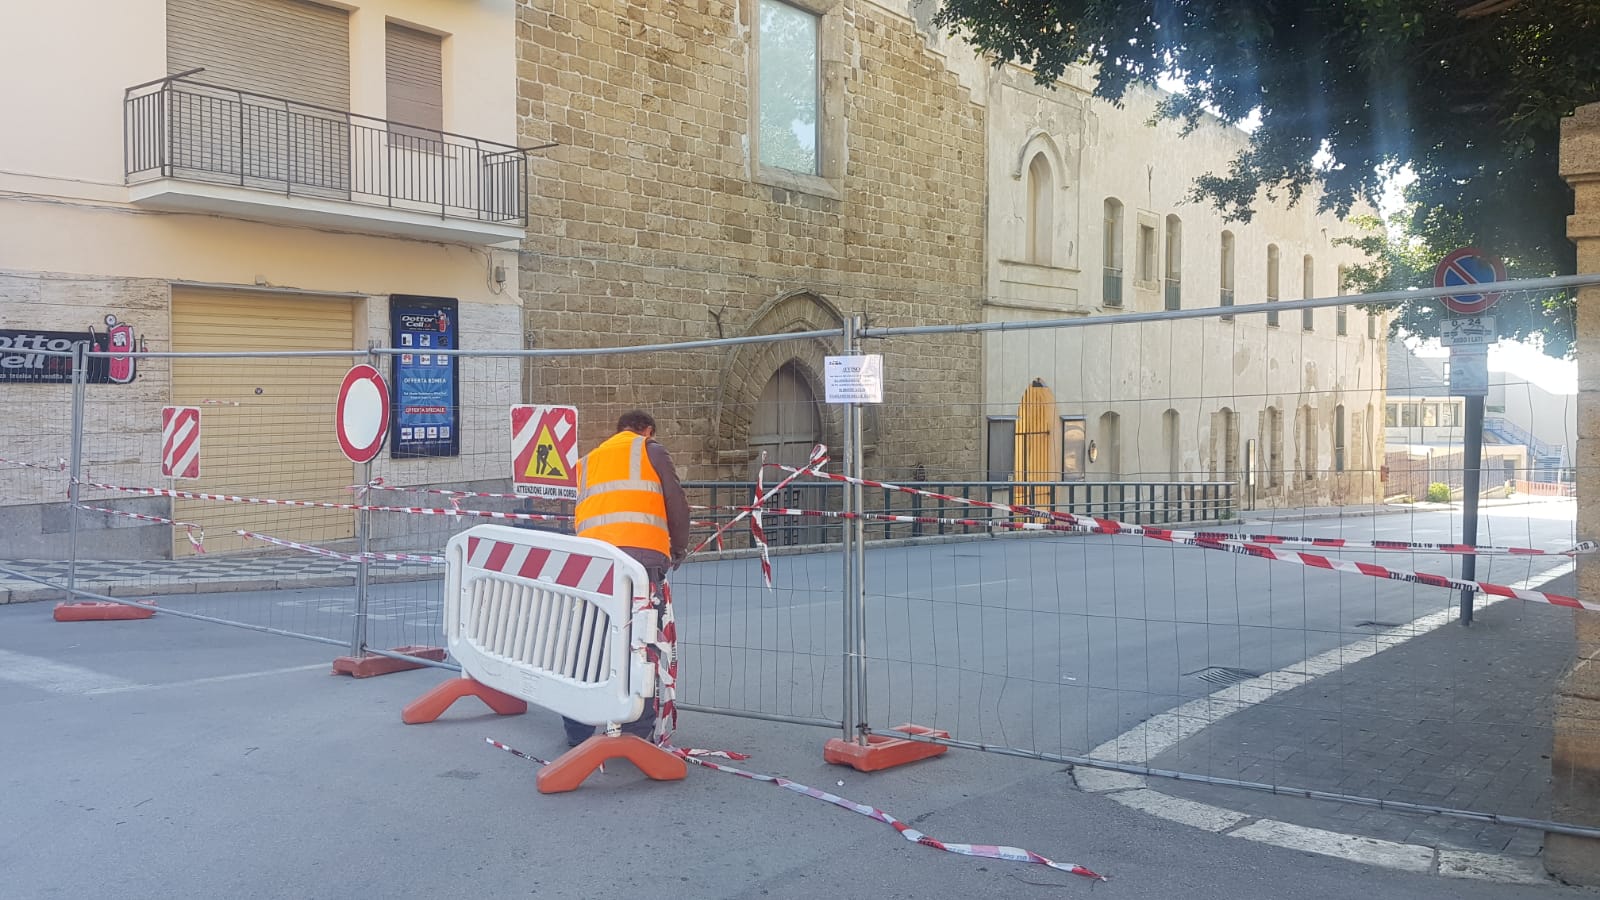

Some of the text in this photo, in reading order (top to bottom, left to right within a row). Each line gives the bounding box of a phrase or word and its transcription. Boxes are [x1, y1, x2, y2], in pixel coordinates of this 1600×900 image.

[0, 353, 45, 369] ell
[517, 485, 542, 495] ATTENZIONE
[543, 486, 557, 496] LAVORI
